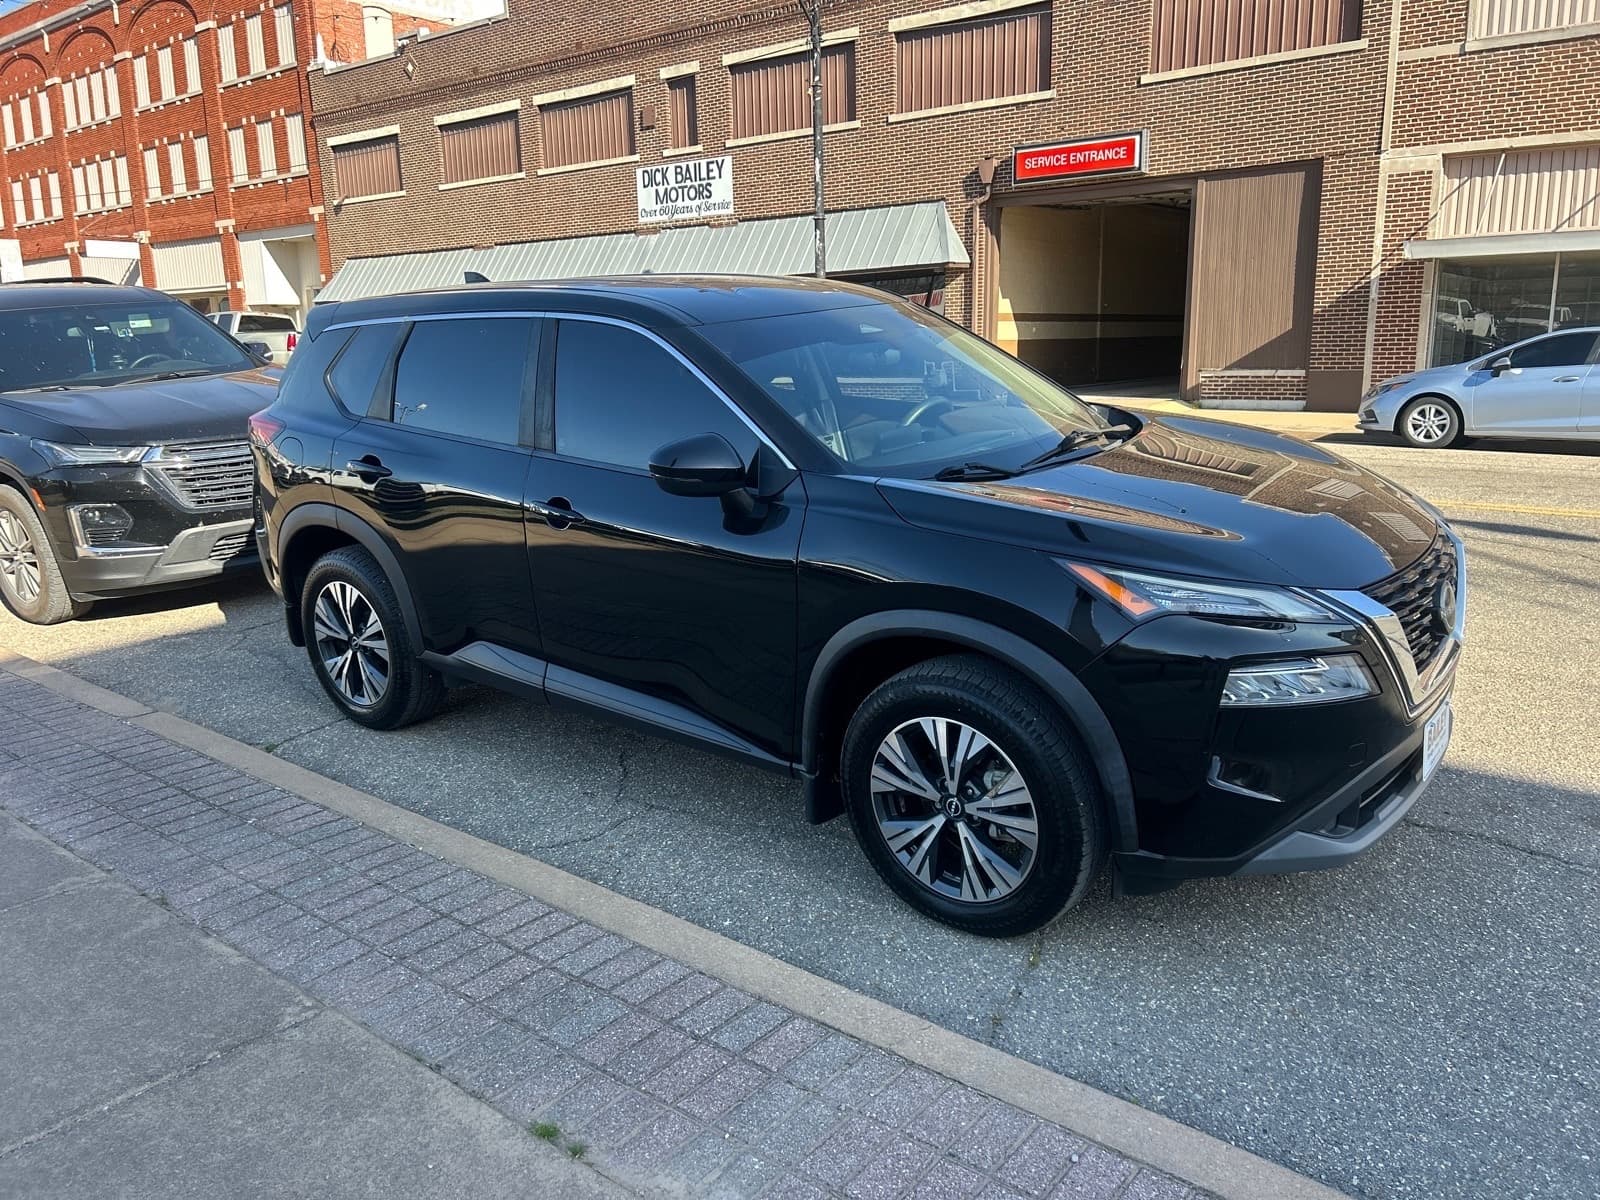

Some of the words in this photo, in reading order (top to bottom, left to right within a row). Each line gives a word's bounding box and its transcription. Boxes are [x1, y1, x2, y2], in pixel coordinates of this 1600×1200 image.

[1024, 153, 1068, 169] SERVICE
[1069, 146, 1128, 165] ENTRANCE
[642, 166, 670, 188] DICK
[674, 158, 725, 185] BAILEY
[655, 182, 713, 205] MOTORS
[640, 207, 658, 218] Over
[694, 201, 703, 217] of
[703, 199, 731, 213] Service
